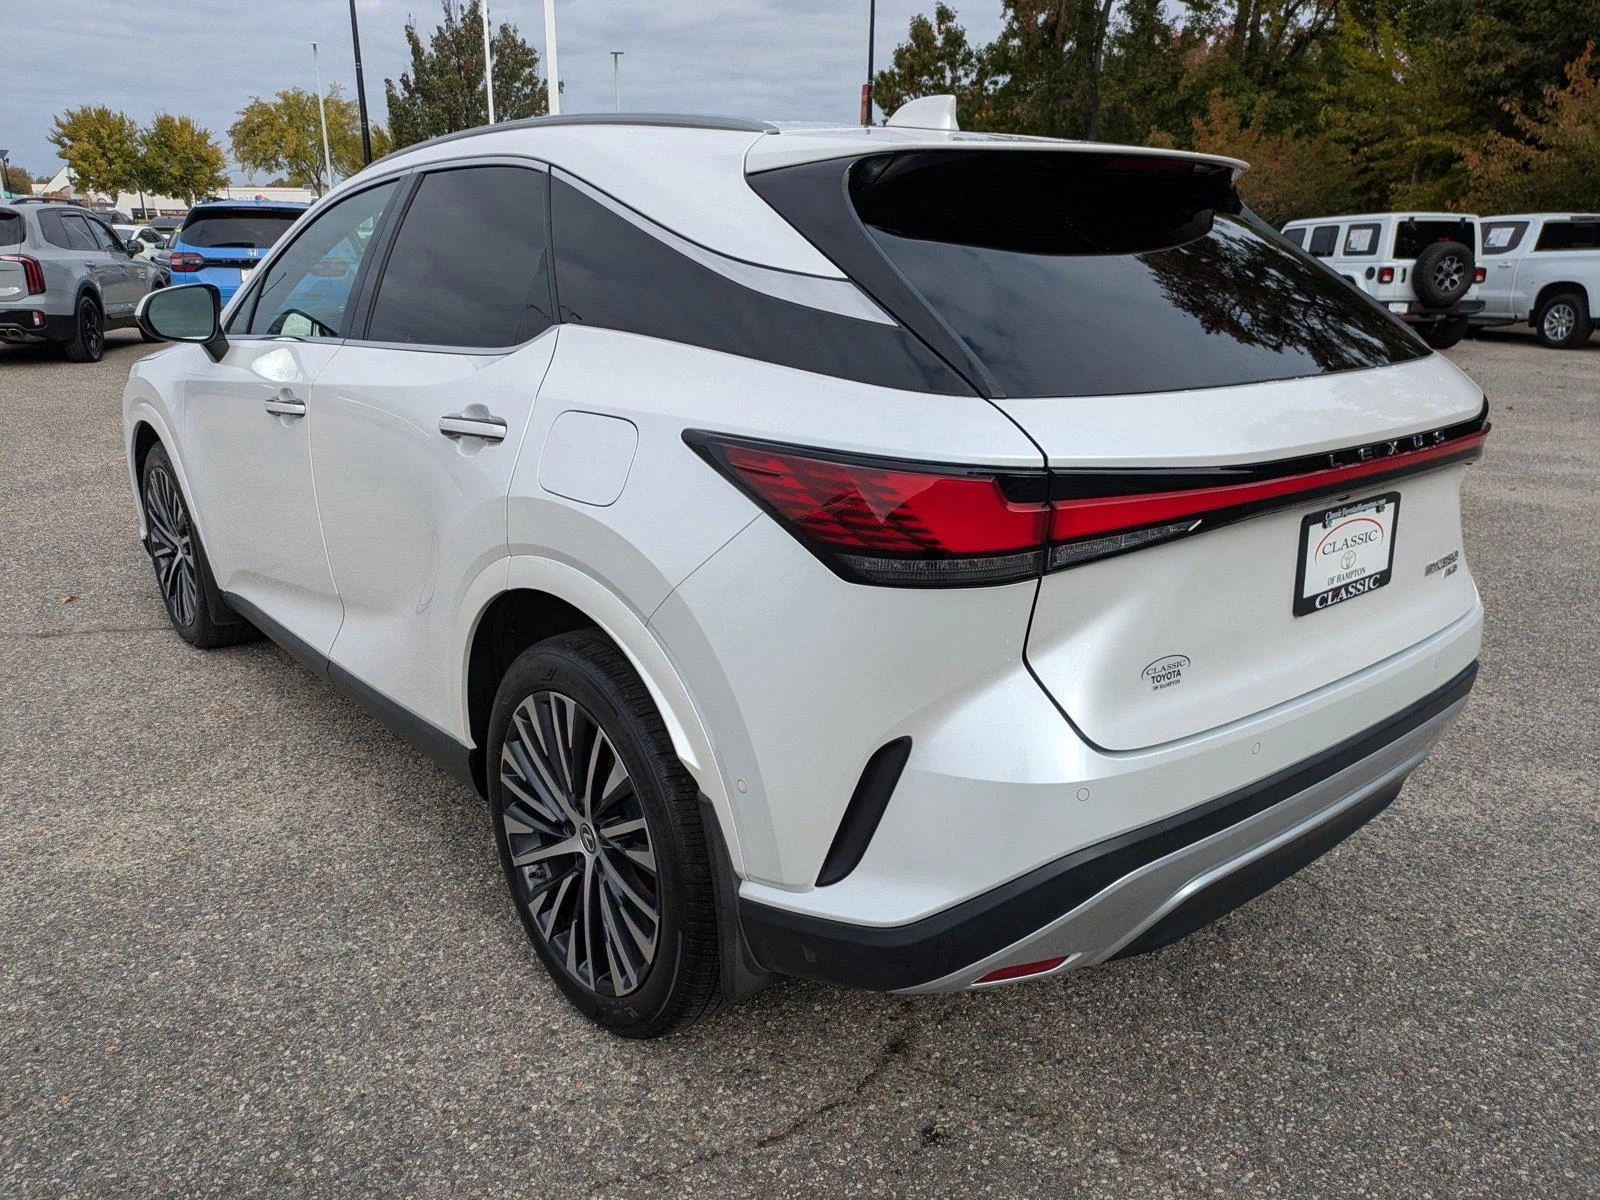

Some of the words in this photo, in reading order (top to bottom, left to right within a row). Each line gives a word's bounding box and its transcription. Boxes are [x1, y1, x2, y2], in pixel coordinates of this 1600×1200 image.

[1329, 431, 1445, 467] LEXUS
[1322, 529, 1378, 556] CLASSIC
[1327, 576, 1338, 586] OF
[1336, 566, 1367, 584] HAMPTON
[1315, 574, 1381, 609] CLASSIC
[1146, 659, 1187, 676] CLASSIC
[1151, 669, 1182, 684] TOYOTA
